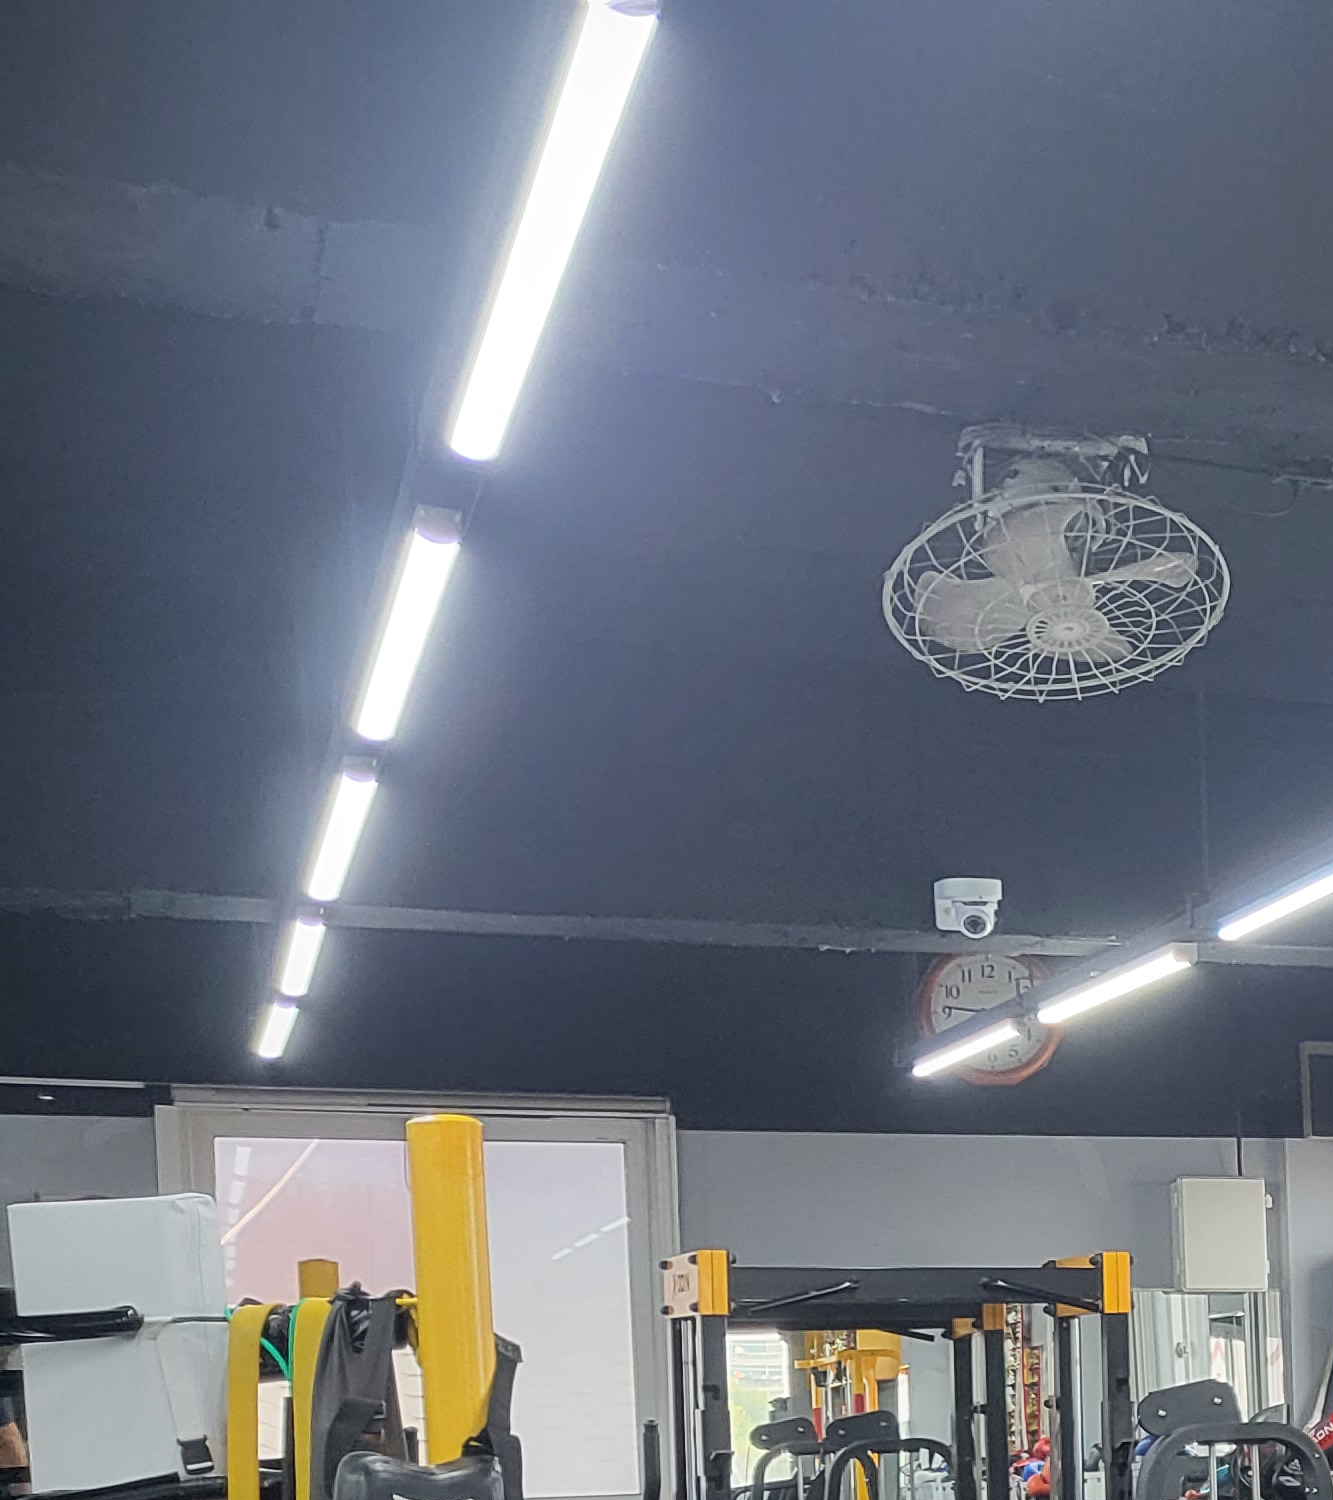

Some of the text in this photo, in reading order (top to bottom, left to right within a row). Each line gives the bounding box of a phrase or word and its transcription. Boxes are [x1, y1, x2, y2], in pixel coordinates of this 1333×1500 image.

[961, 968, 972, 983] 11
[981, 964, 995, 979] 12
[1008, 970, 1013, 983] 1
[945, 984, 960, 999] 10
[942, 1005, 953, 1020] 9
